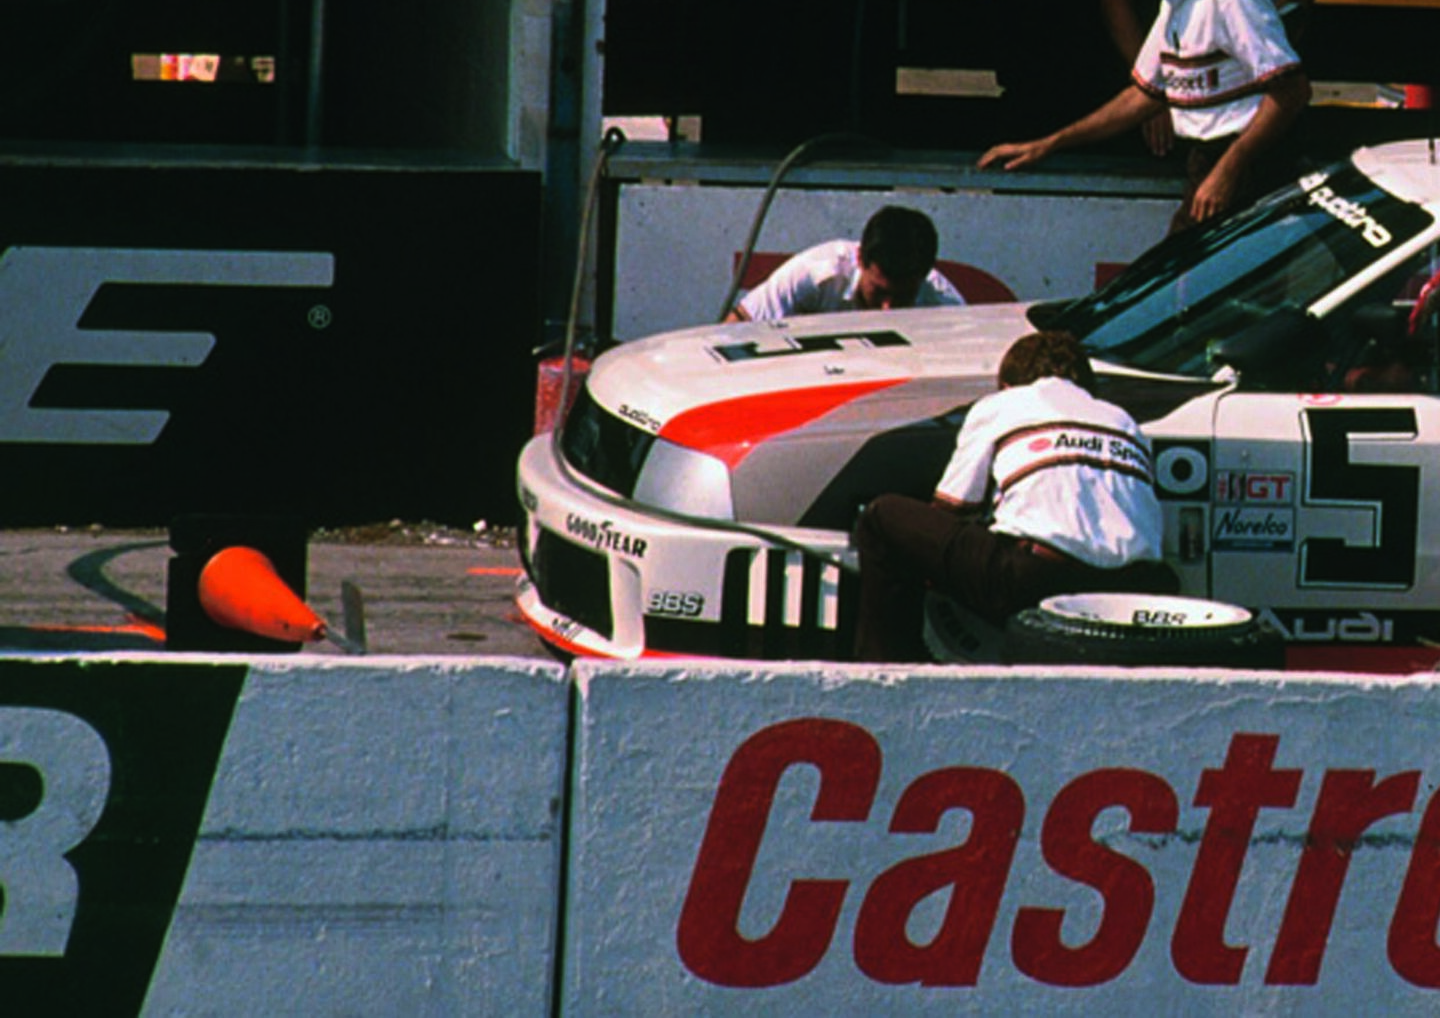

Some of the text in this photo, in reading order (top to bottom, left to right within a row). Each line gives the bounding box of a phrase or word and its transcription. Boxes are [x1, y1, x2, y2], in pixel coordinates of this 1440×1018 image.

[0, 245, 335, 445] E
[1055, 433, 1104, 452] Audi
[1217, 509, 1289, 537] Norelco
[1297, 407, 1421, 590] 5
